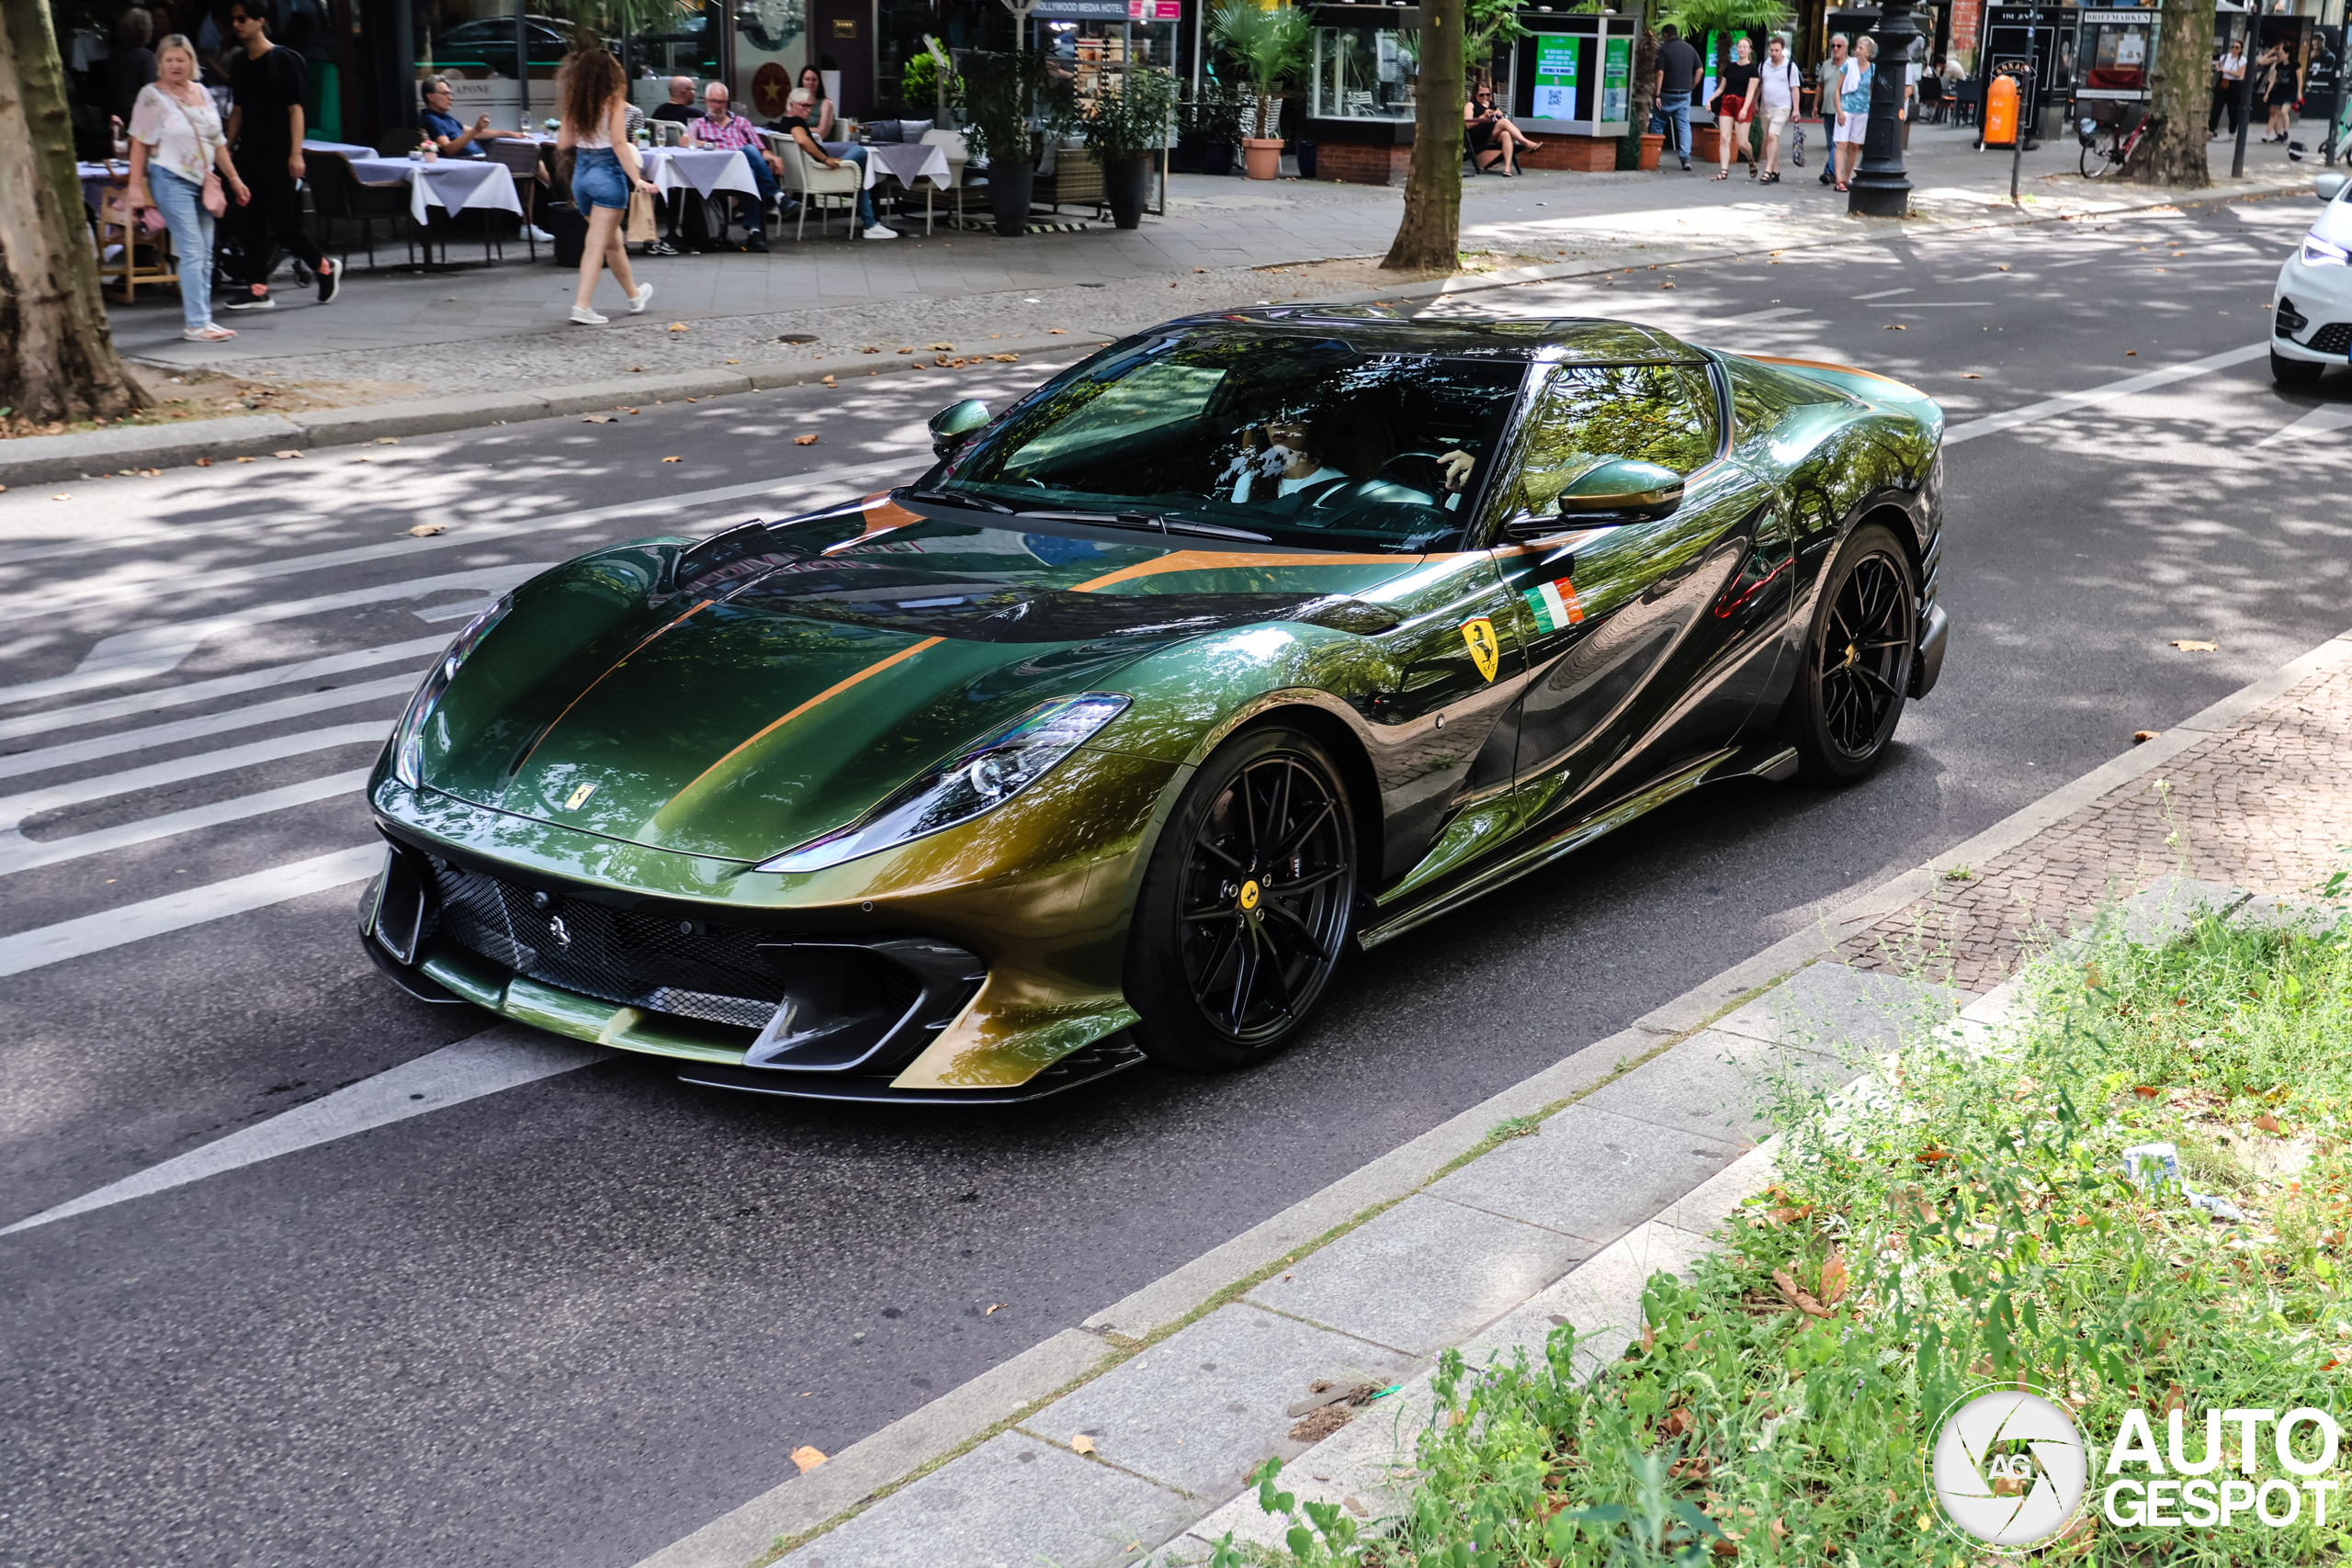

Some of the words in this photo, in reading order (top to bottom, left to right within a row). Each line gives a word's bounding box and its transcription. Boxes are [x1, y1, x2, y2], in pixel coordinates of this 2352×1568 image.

[1035, 2, 1077, 12] HOLLYWOOD
[1078, 3, 1101, 13] MEDIA
[1102, 4, 1125, 14] HOTEL
